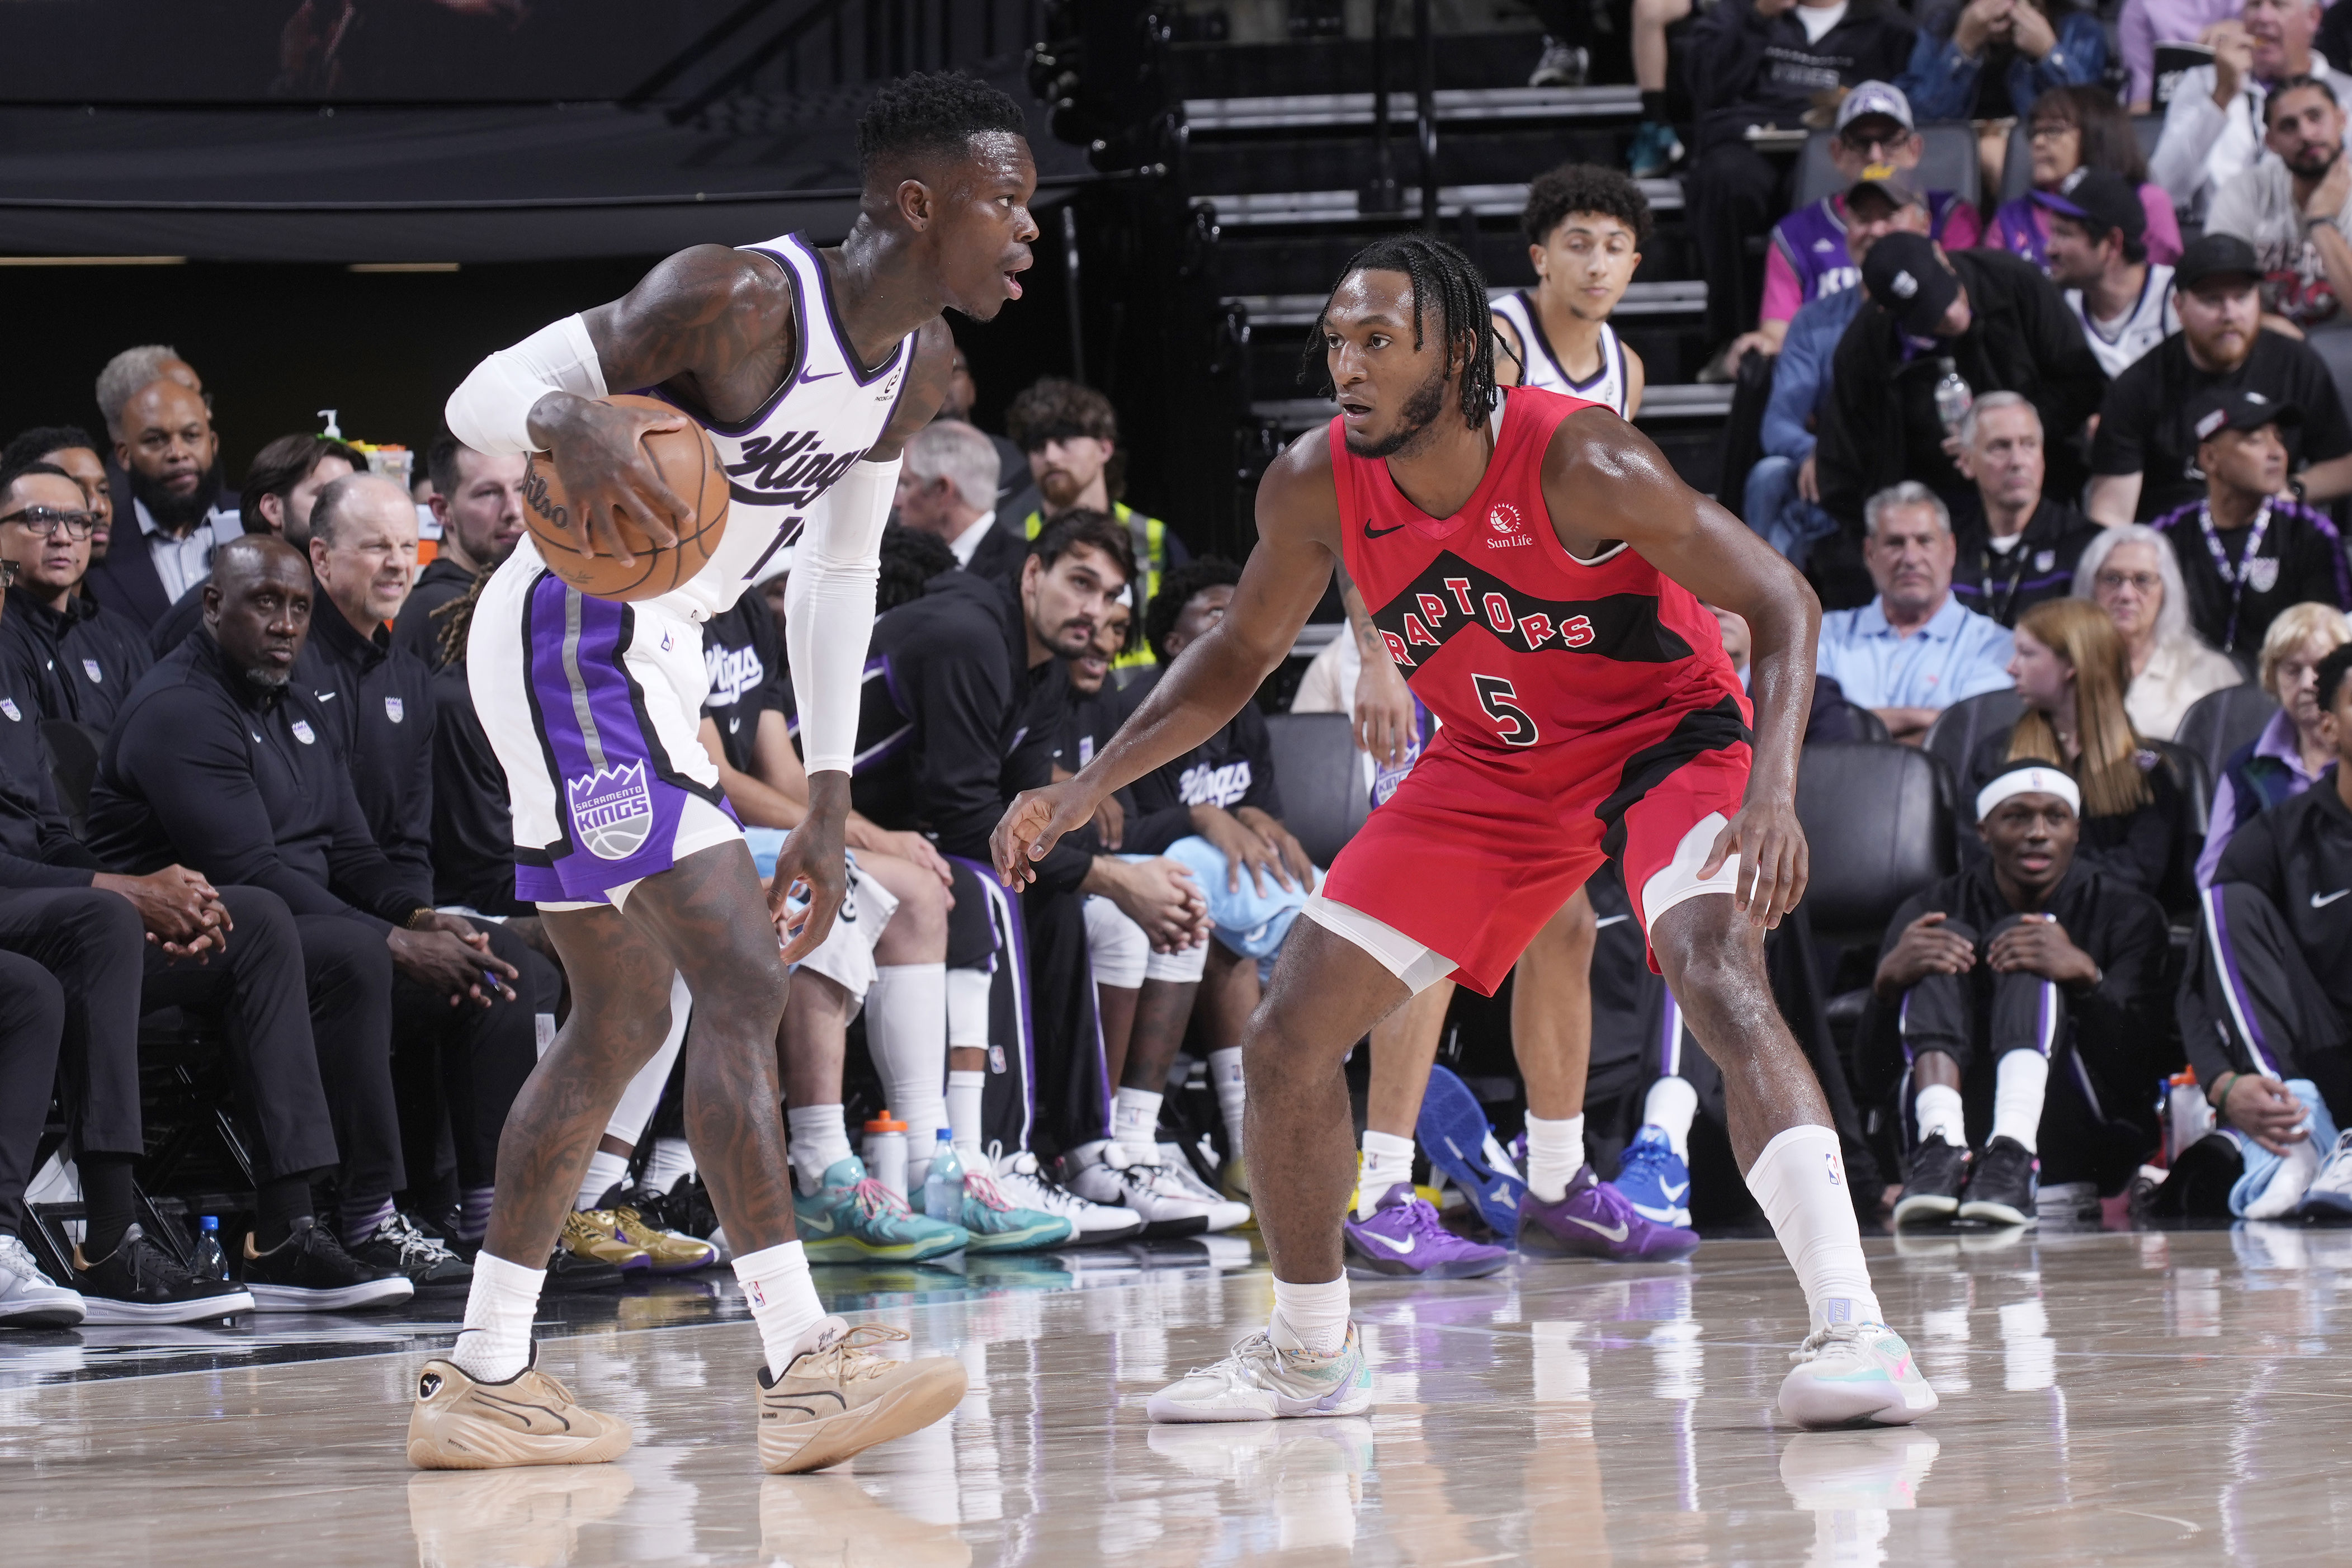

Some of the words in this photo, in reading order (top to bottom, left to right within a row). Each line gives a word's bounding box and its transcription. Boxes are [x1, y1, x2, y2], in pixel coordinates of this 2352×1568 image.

[521, 461, 568, 529] ilso
[1487, 538, 1510, 549] Sun
[1510, 534, 1533, 546] Life
[1378, 577, 1595, 666] RAPTORS
[1471, 673, 1539, 746] 5
[575, 786, 643, 811] SACRAMENTO
[577, 796, 649, 832] KINGS
